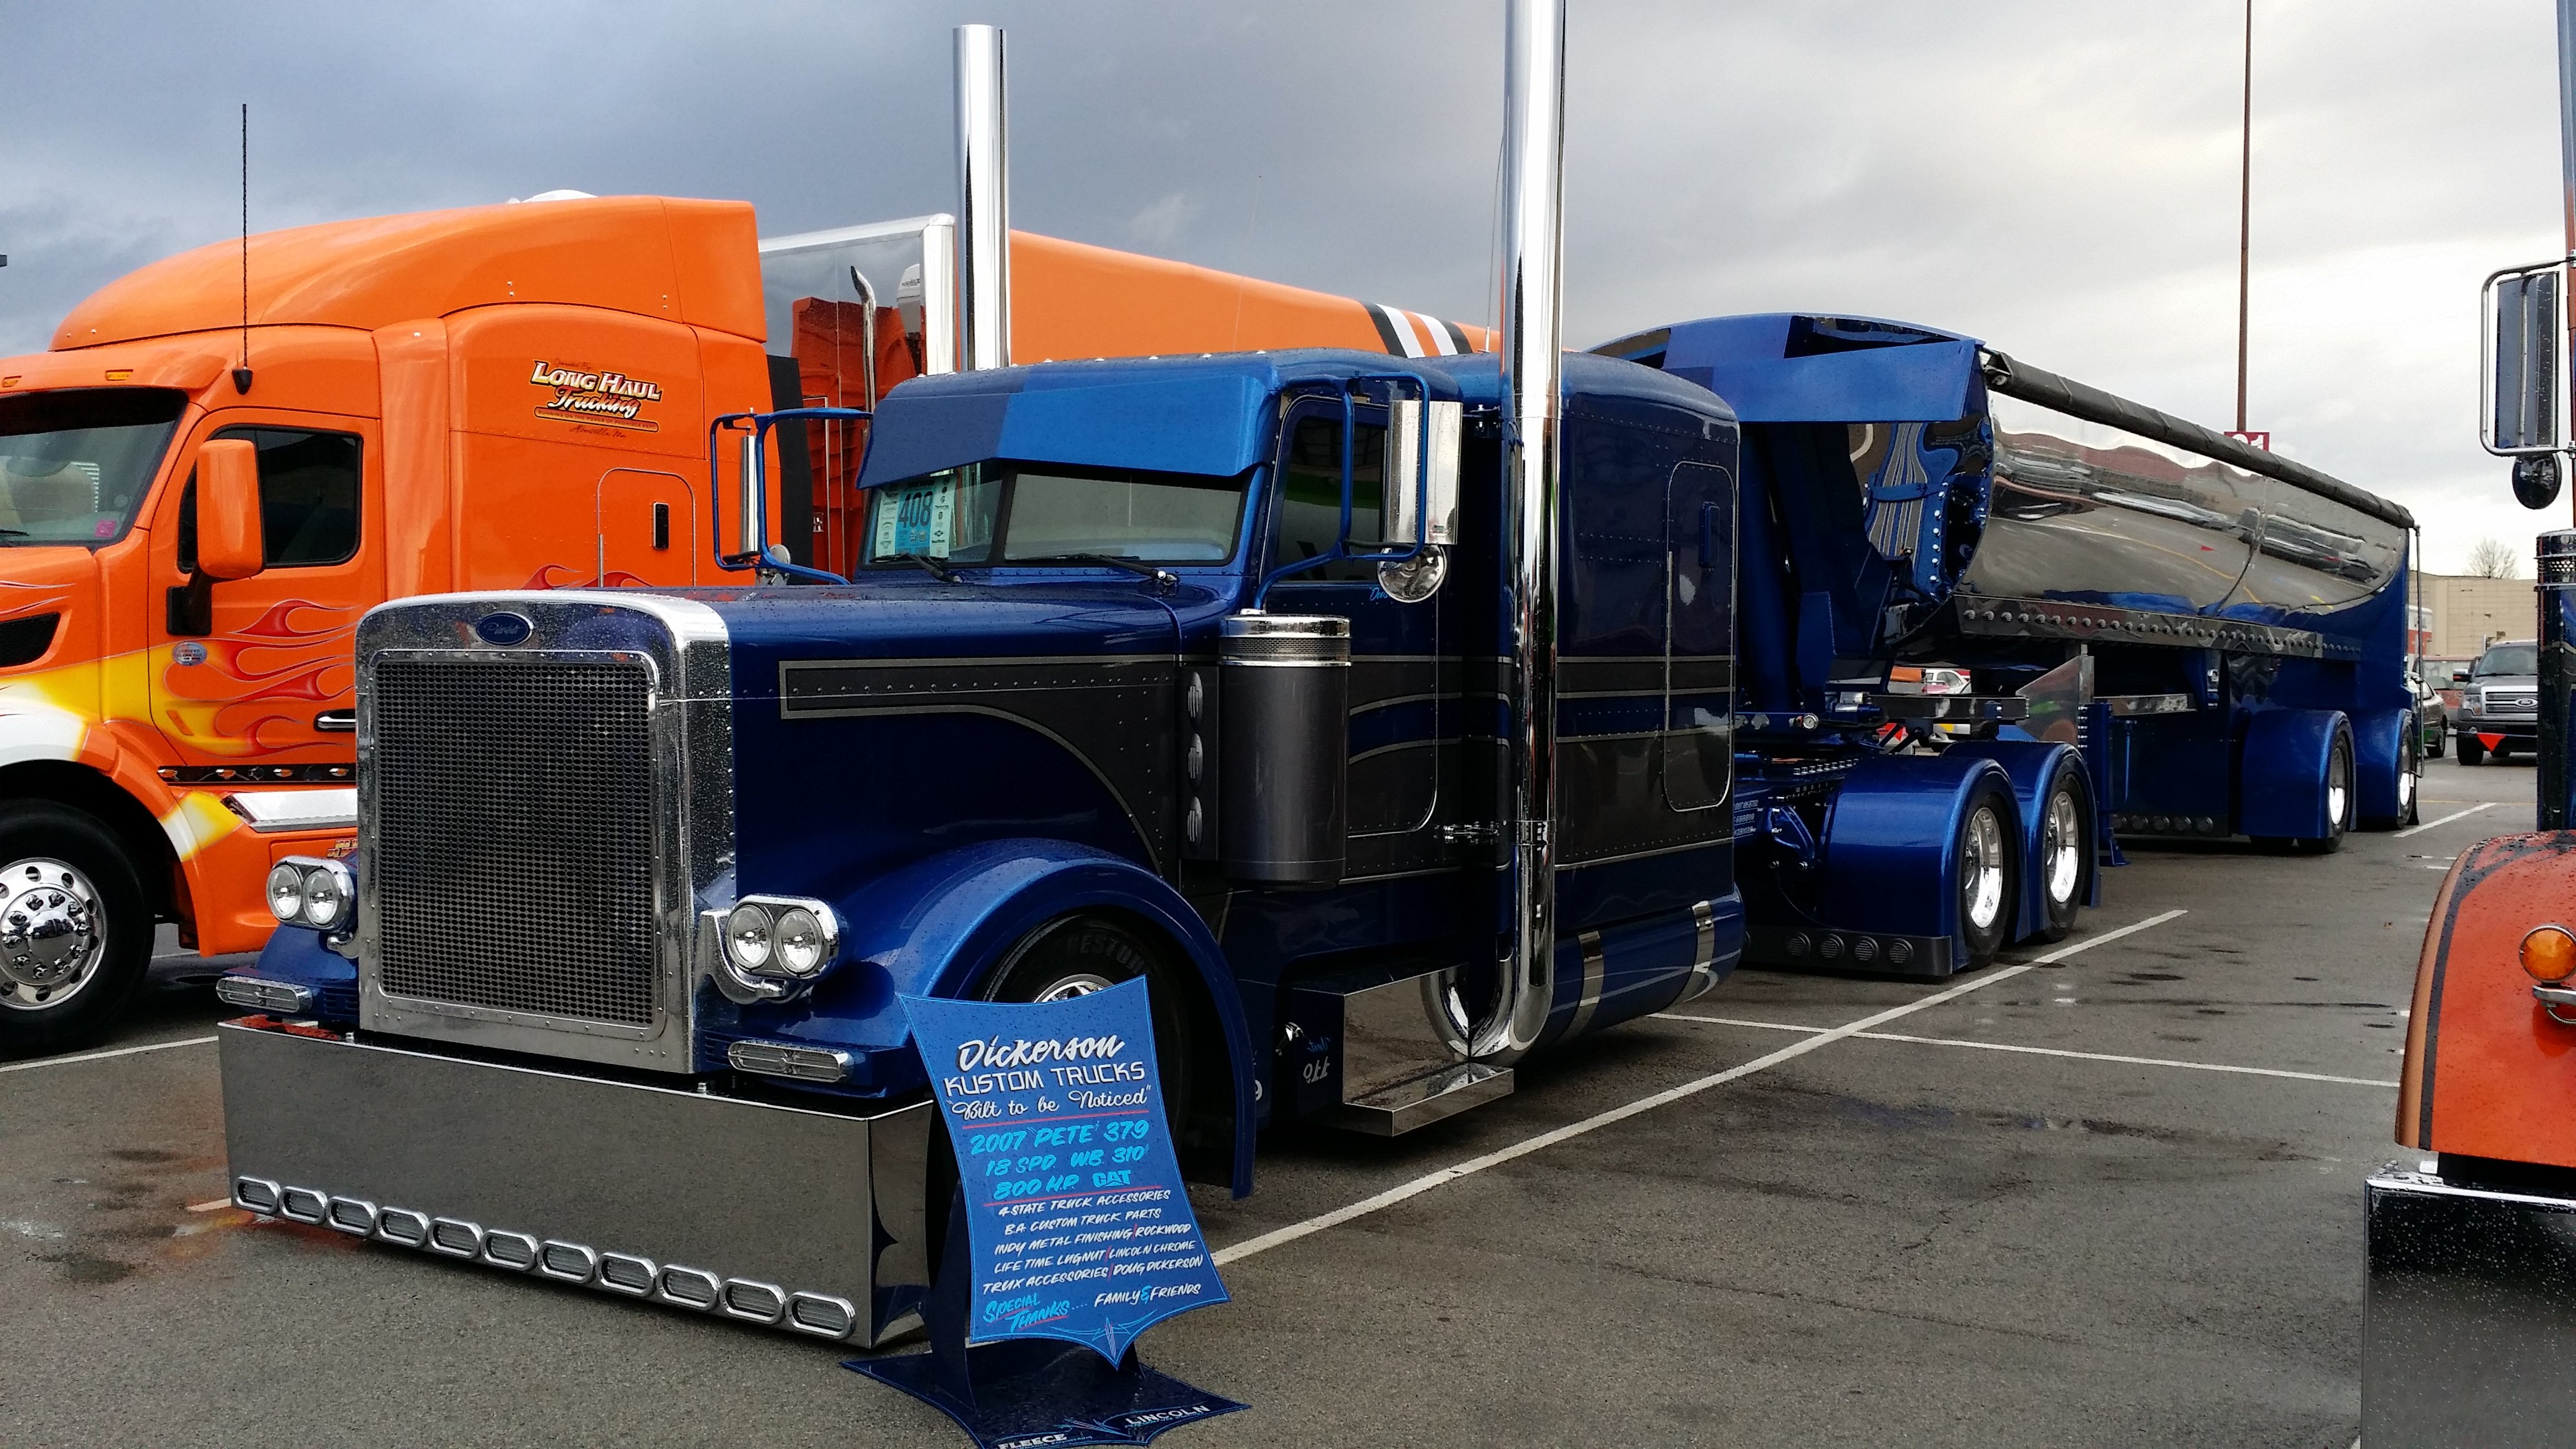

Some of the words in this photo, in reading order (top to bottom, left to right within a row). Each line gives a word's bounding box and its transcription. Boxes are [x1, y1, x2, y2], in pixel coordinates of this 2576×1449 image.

[530, 360, 598, 391] LONG
[598, 371, 662, 401] HAUL
[547, 386, 641, 419] Trucking
[898, 490, 934, 529] 408
[957, 1033, 1126, 1072] Dickerson
[944, 1070, 1045, 1097] KUSTOM
[1050, 1061, 1146, 1087] TRUCKS
[1008, 1100, 1028, 1116] to
[1037, 1096, 1060, 1113] be
[970, 1130, 1027, 1155] 2007
[1103, 1120, 1149, 1143] 379
[986, 1159, 1012, 1176] 18
[993, 1179, 1042, 1200] 800
[1093, 1169, 1131, 1187] CAT
[1050, 1197, 1093, 1211] TRUCK
[1096, 1189, 1171, 1206] ACCESSORIES
[1030, 1217, 1078, 1232] CUSTOM
[1081, 1212, 1122, 1226] TRUCK
[1125, 1208, 1162, 1221] PARTS
[994, 1241, 1027, 1257] INDY
[1028, 1236, 1072, 1251] METAL
[1134, 1223, 1192, 1237] ROCKWOOD
[994, 1260, 1023, 1274] LIFE
[1024, 1256, 1054, 1270] TIME
[1056, 1250, 1107, 1266] LUGNUT
[1108, 1244, 1153, 1259] LINCOLN
[1153, 1240, 1196, 1253] CHROME
[983, 1278, 1025, 1295] TRUX
[1025, 1267, 1108, 1287] ACCESSORIES
[1113, 1262, 1146, 1276] DOUG
[1146, 1254, 1203, 1271] DICKERSON
[983, 1292, 1040, 1323] SPECIAL
[1125, 1405, 1211, 1425] LINCOLN
[997, 1433, 1068, 1449] FLEECE
